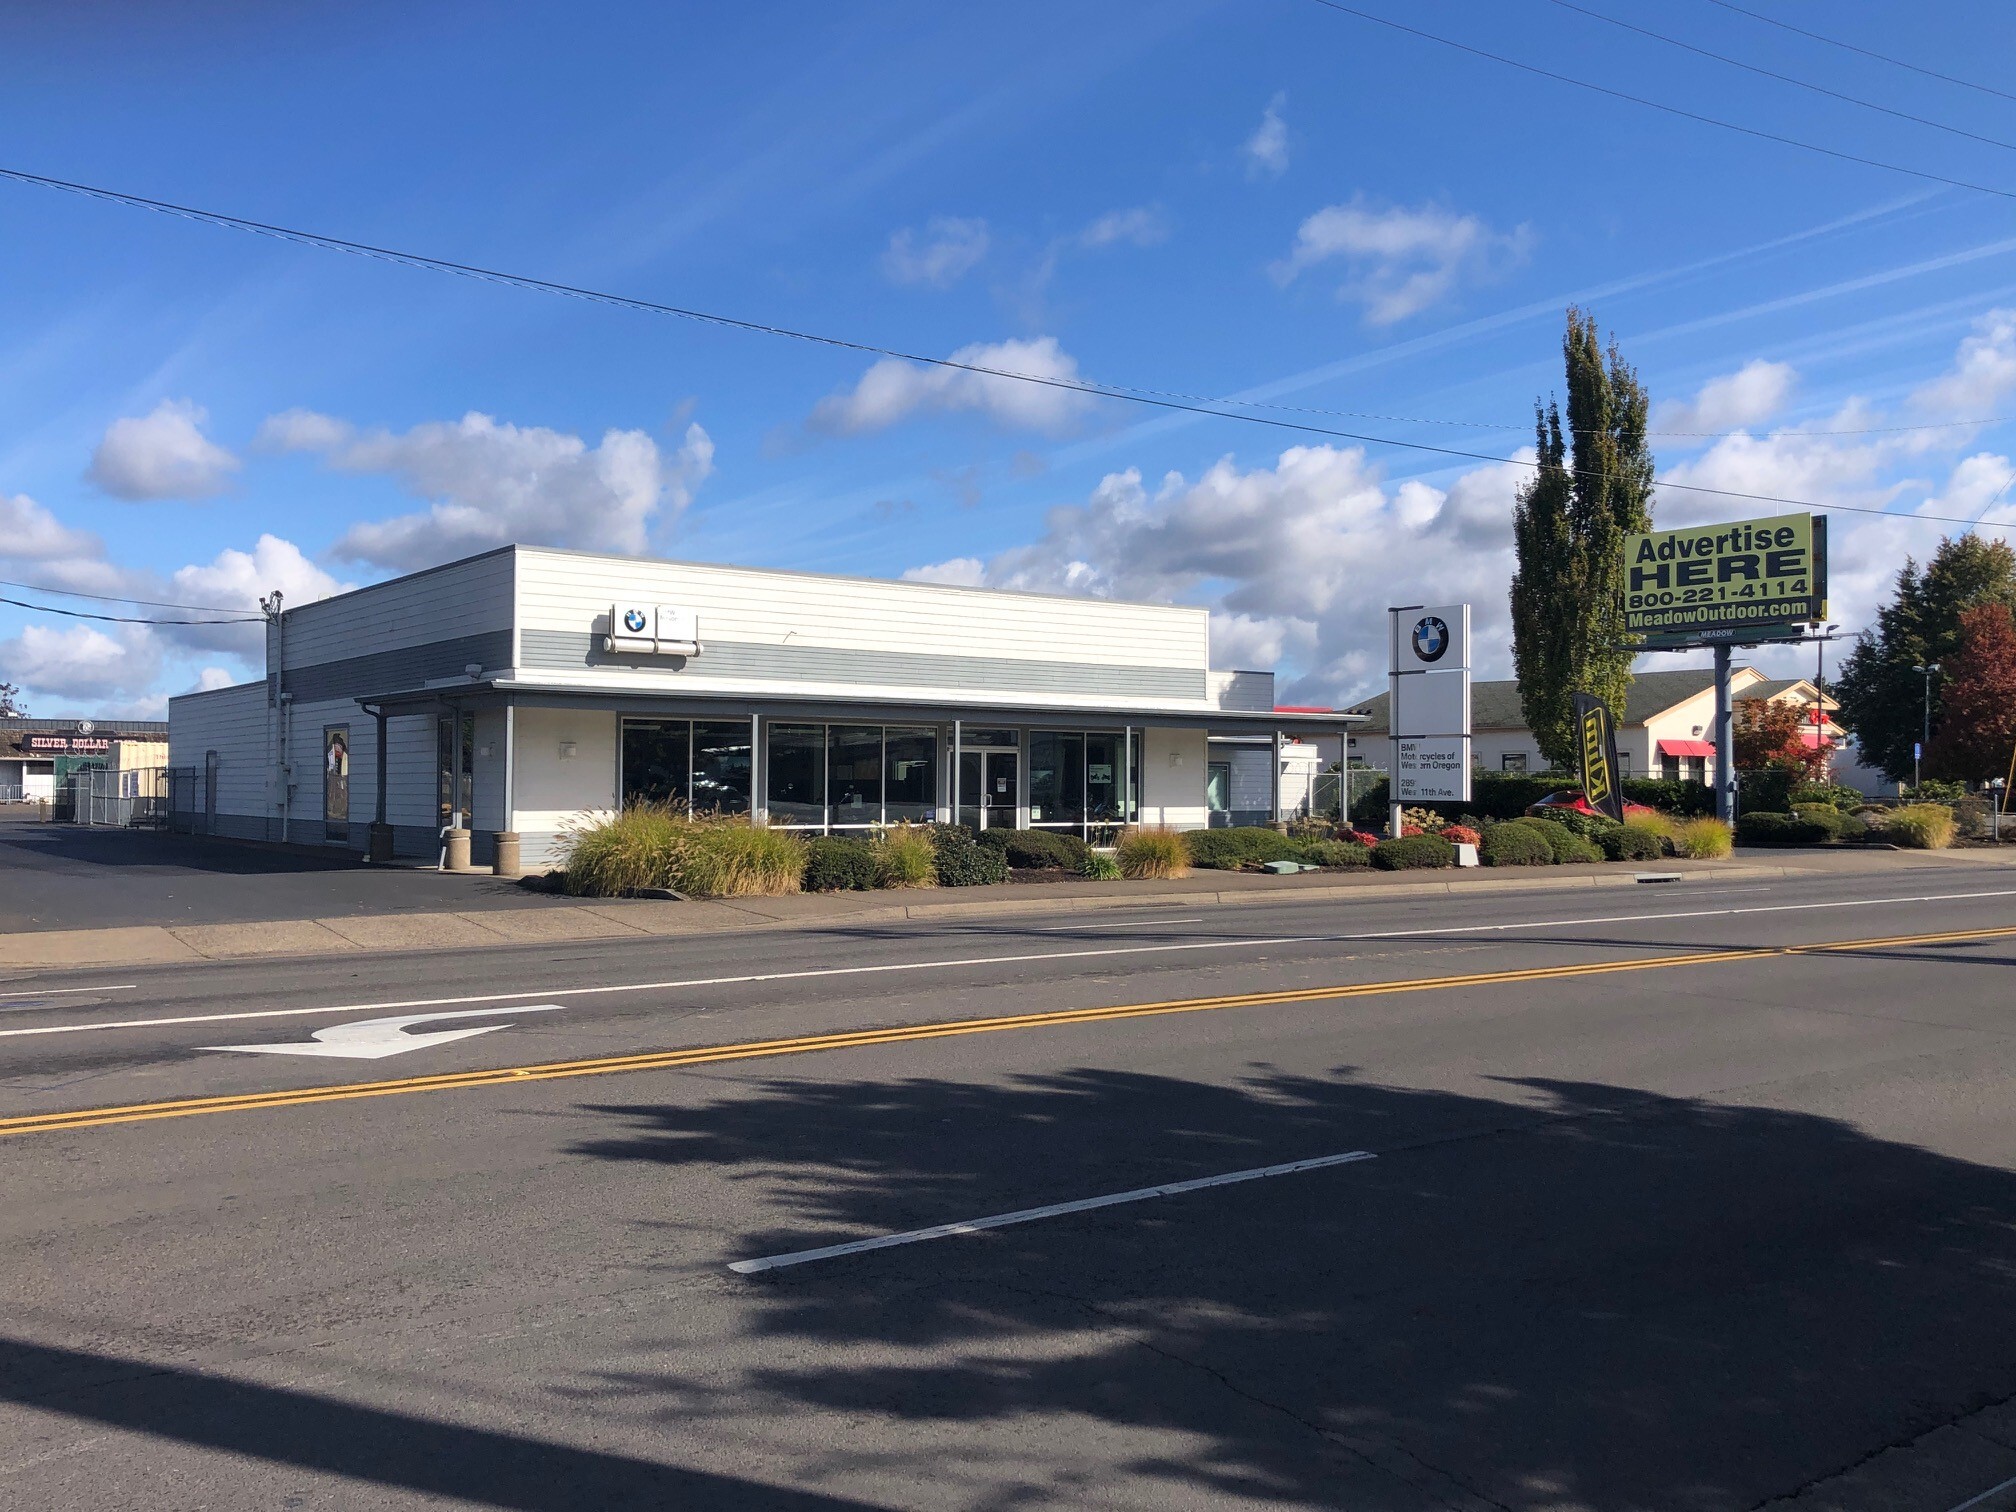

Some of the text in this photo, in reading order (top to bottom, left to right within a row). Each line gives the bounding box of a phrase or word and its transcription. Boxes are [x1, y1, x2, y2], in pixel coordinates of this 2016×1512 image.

[1636, 525, 1795, 564] Advertise
[1630, 548, 1807, 591] HERE
[1629, 579, 1808, 609] 800-221-4114
[1629, 601, 1808, 628] MeadowOutdoor.com
[1414, 617, 1445, 634] BMW
[31, 737, 109, 749] SILVER DOLLAR
[1400, 751, 1456, 762] Motrcycles of
[1432, 761, 1461, 771] Oregon
[1420, 788, 1437, 796] 11th
[1438, 788, 1455, 797] Ave.
